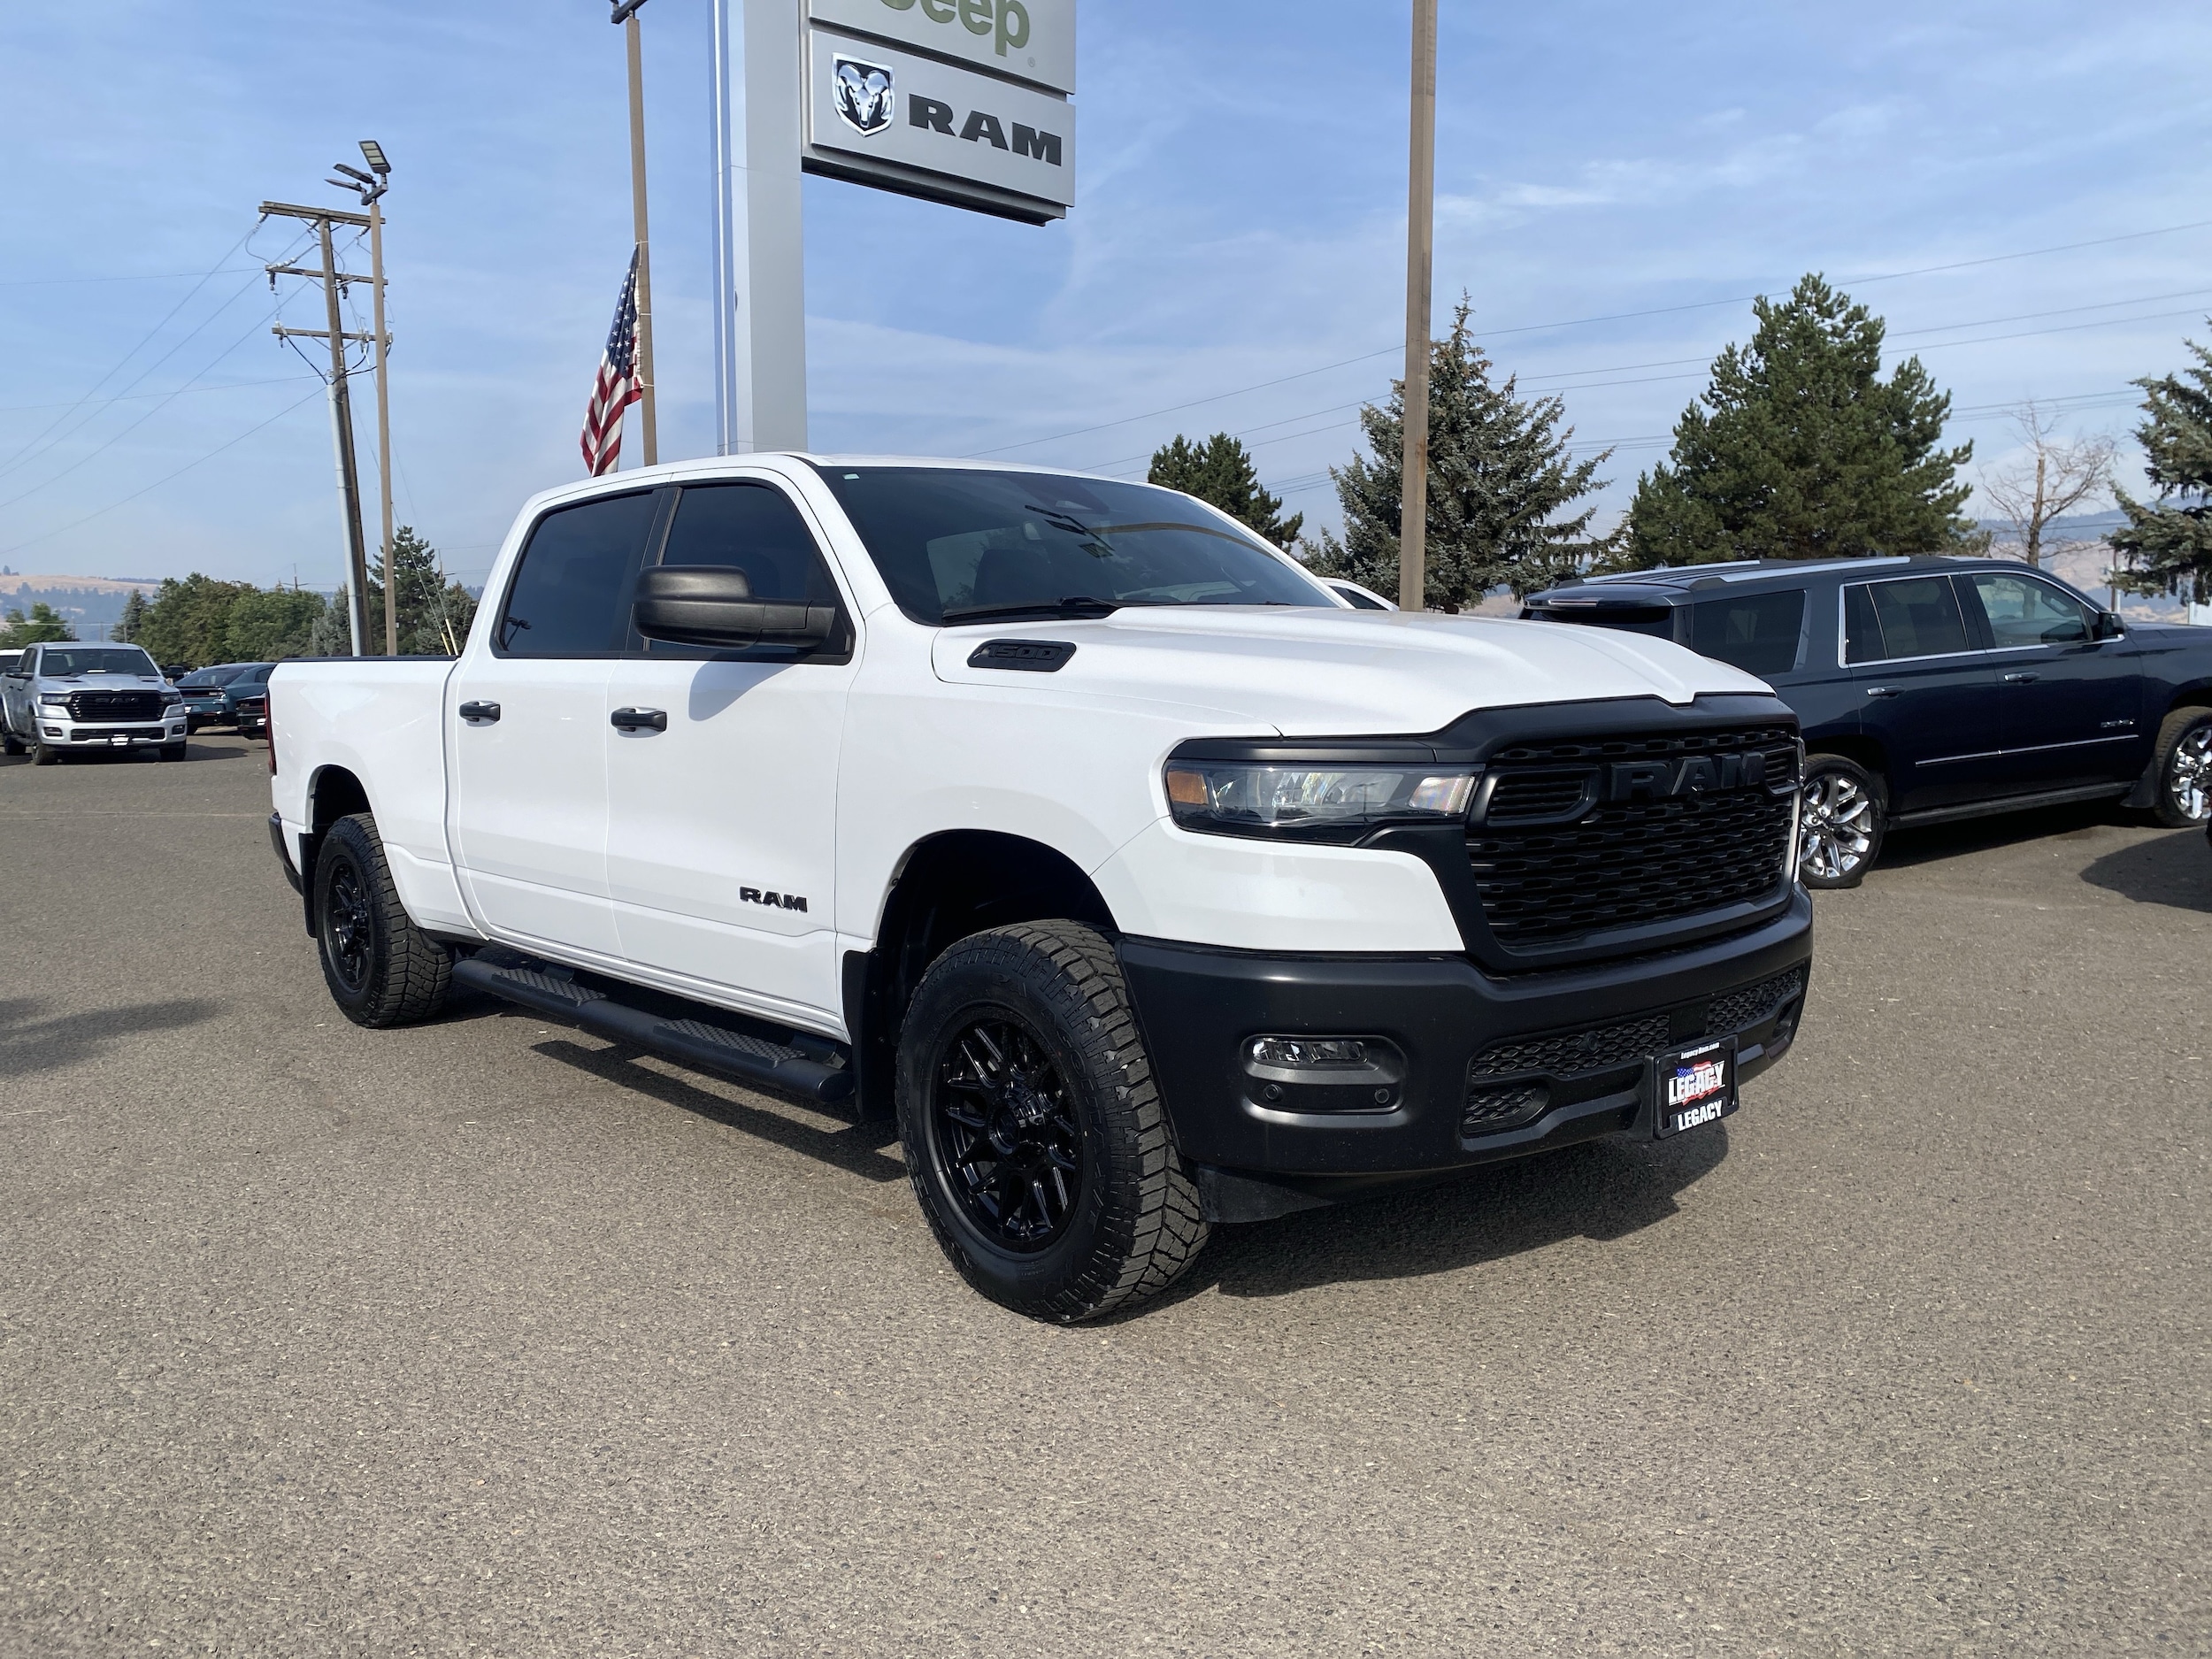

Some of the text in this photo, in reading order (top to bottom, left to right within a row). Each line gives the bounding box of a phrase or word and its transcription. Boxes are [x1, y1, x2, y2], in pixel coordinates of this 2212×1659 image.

[879, 0, 1029, 57] eep
[909, 93, 1061, 166] RAM
[987, 644, 1059, 660] 1500
[1610, 751, 1764, 801] RAM
[740, 886, 808, 913] RAM
[1669, 1064, 1724, 1103] LEGACY
[1678, 1101, 1722, 1131] LEGACY
